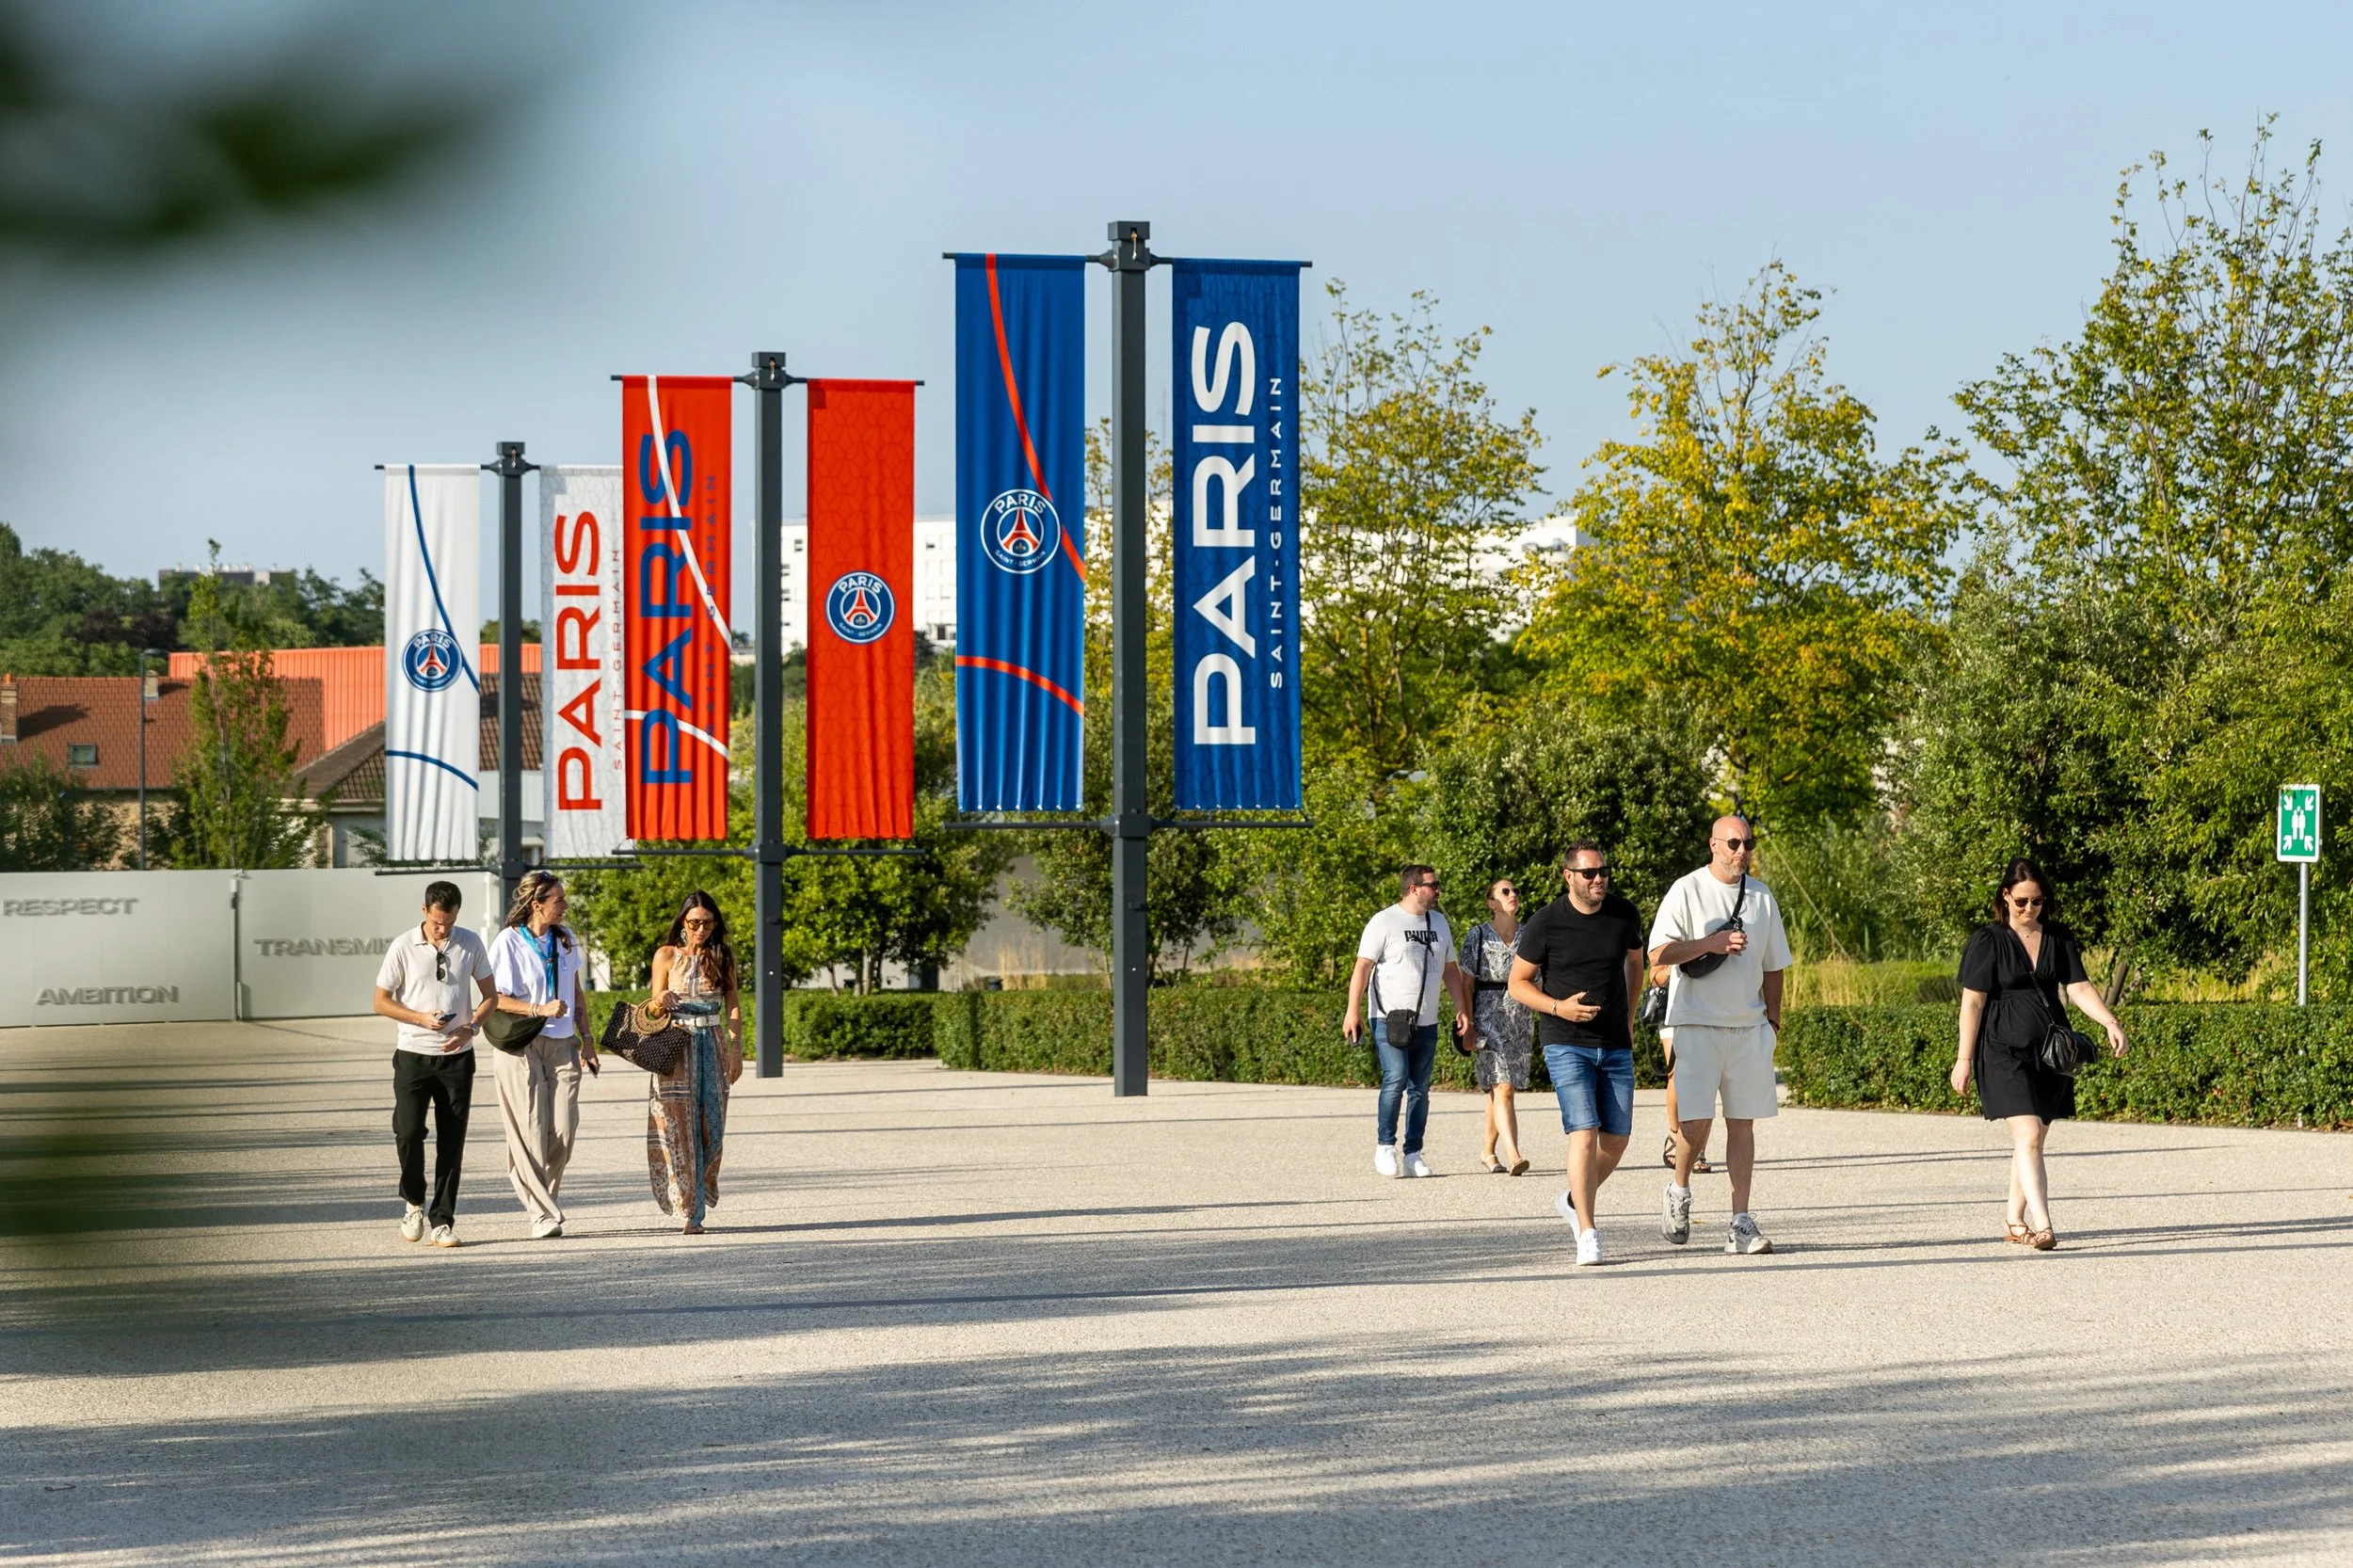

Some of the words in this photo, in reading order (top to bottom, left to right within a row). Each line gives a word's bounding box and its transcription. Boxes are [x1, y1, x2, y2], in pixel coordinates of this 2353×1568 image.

[994, 493, 1047, 514] PARIS
[1192, 321, 1257, 745] PARIS
[1270, 376, 1284, 689] SAINT-GERMAIN
[838, 575, 883, 594] PARIS
[639, 428, 693, 784] PARIS
[413, 632, 452, 648] PARIS
[553, 510, 603, 810] PARIS
[3, 897, 139, 917] RESPECT
[35, 984, 180, 1005] AMBITION
